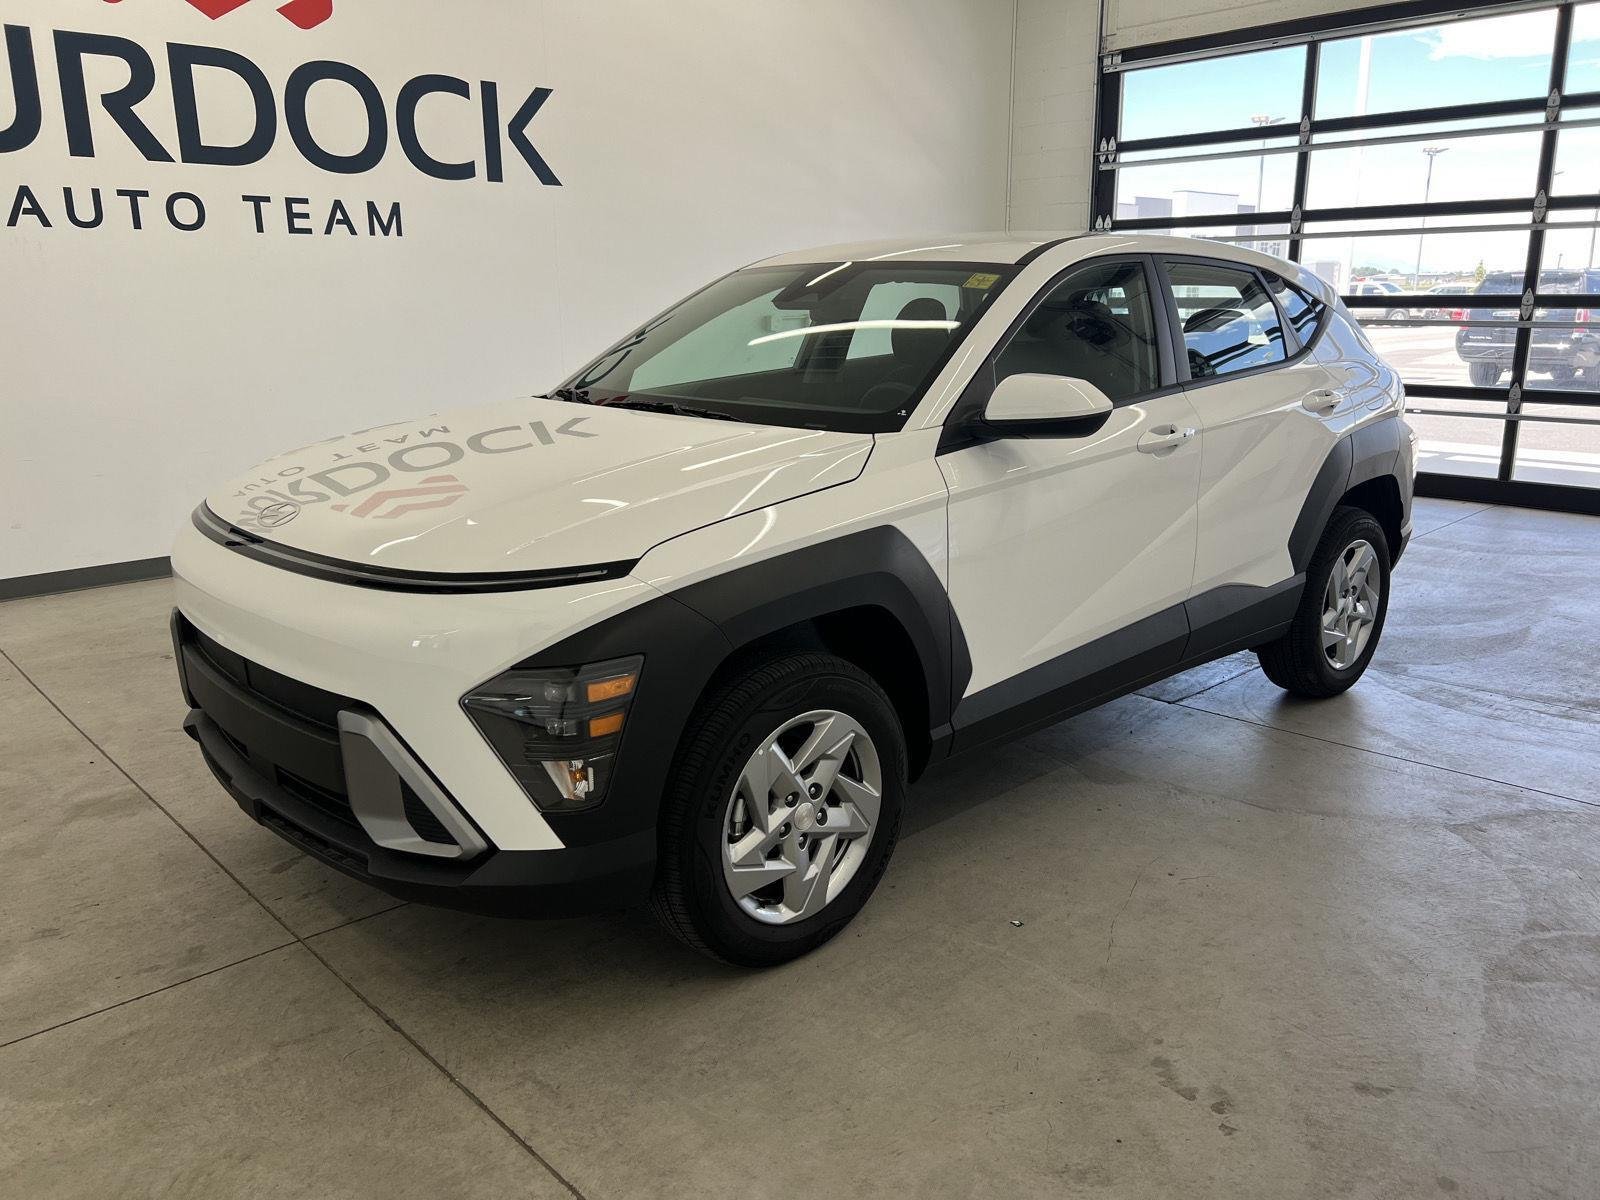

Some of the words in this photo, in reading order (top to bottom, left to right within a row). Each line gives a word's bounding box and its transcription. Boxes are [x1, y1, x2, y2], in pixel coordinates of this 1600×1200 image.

[7, 185, 205, 232] AUTO
[242, 195, 403, 237] TEAM
[703, 732, 751, 820] KUMHO
